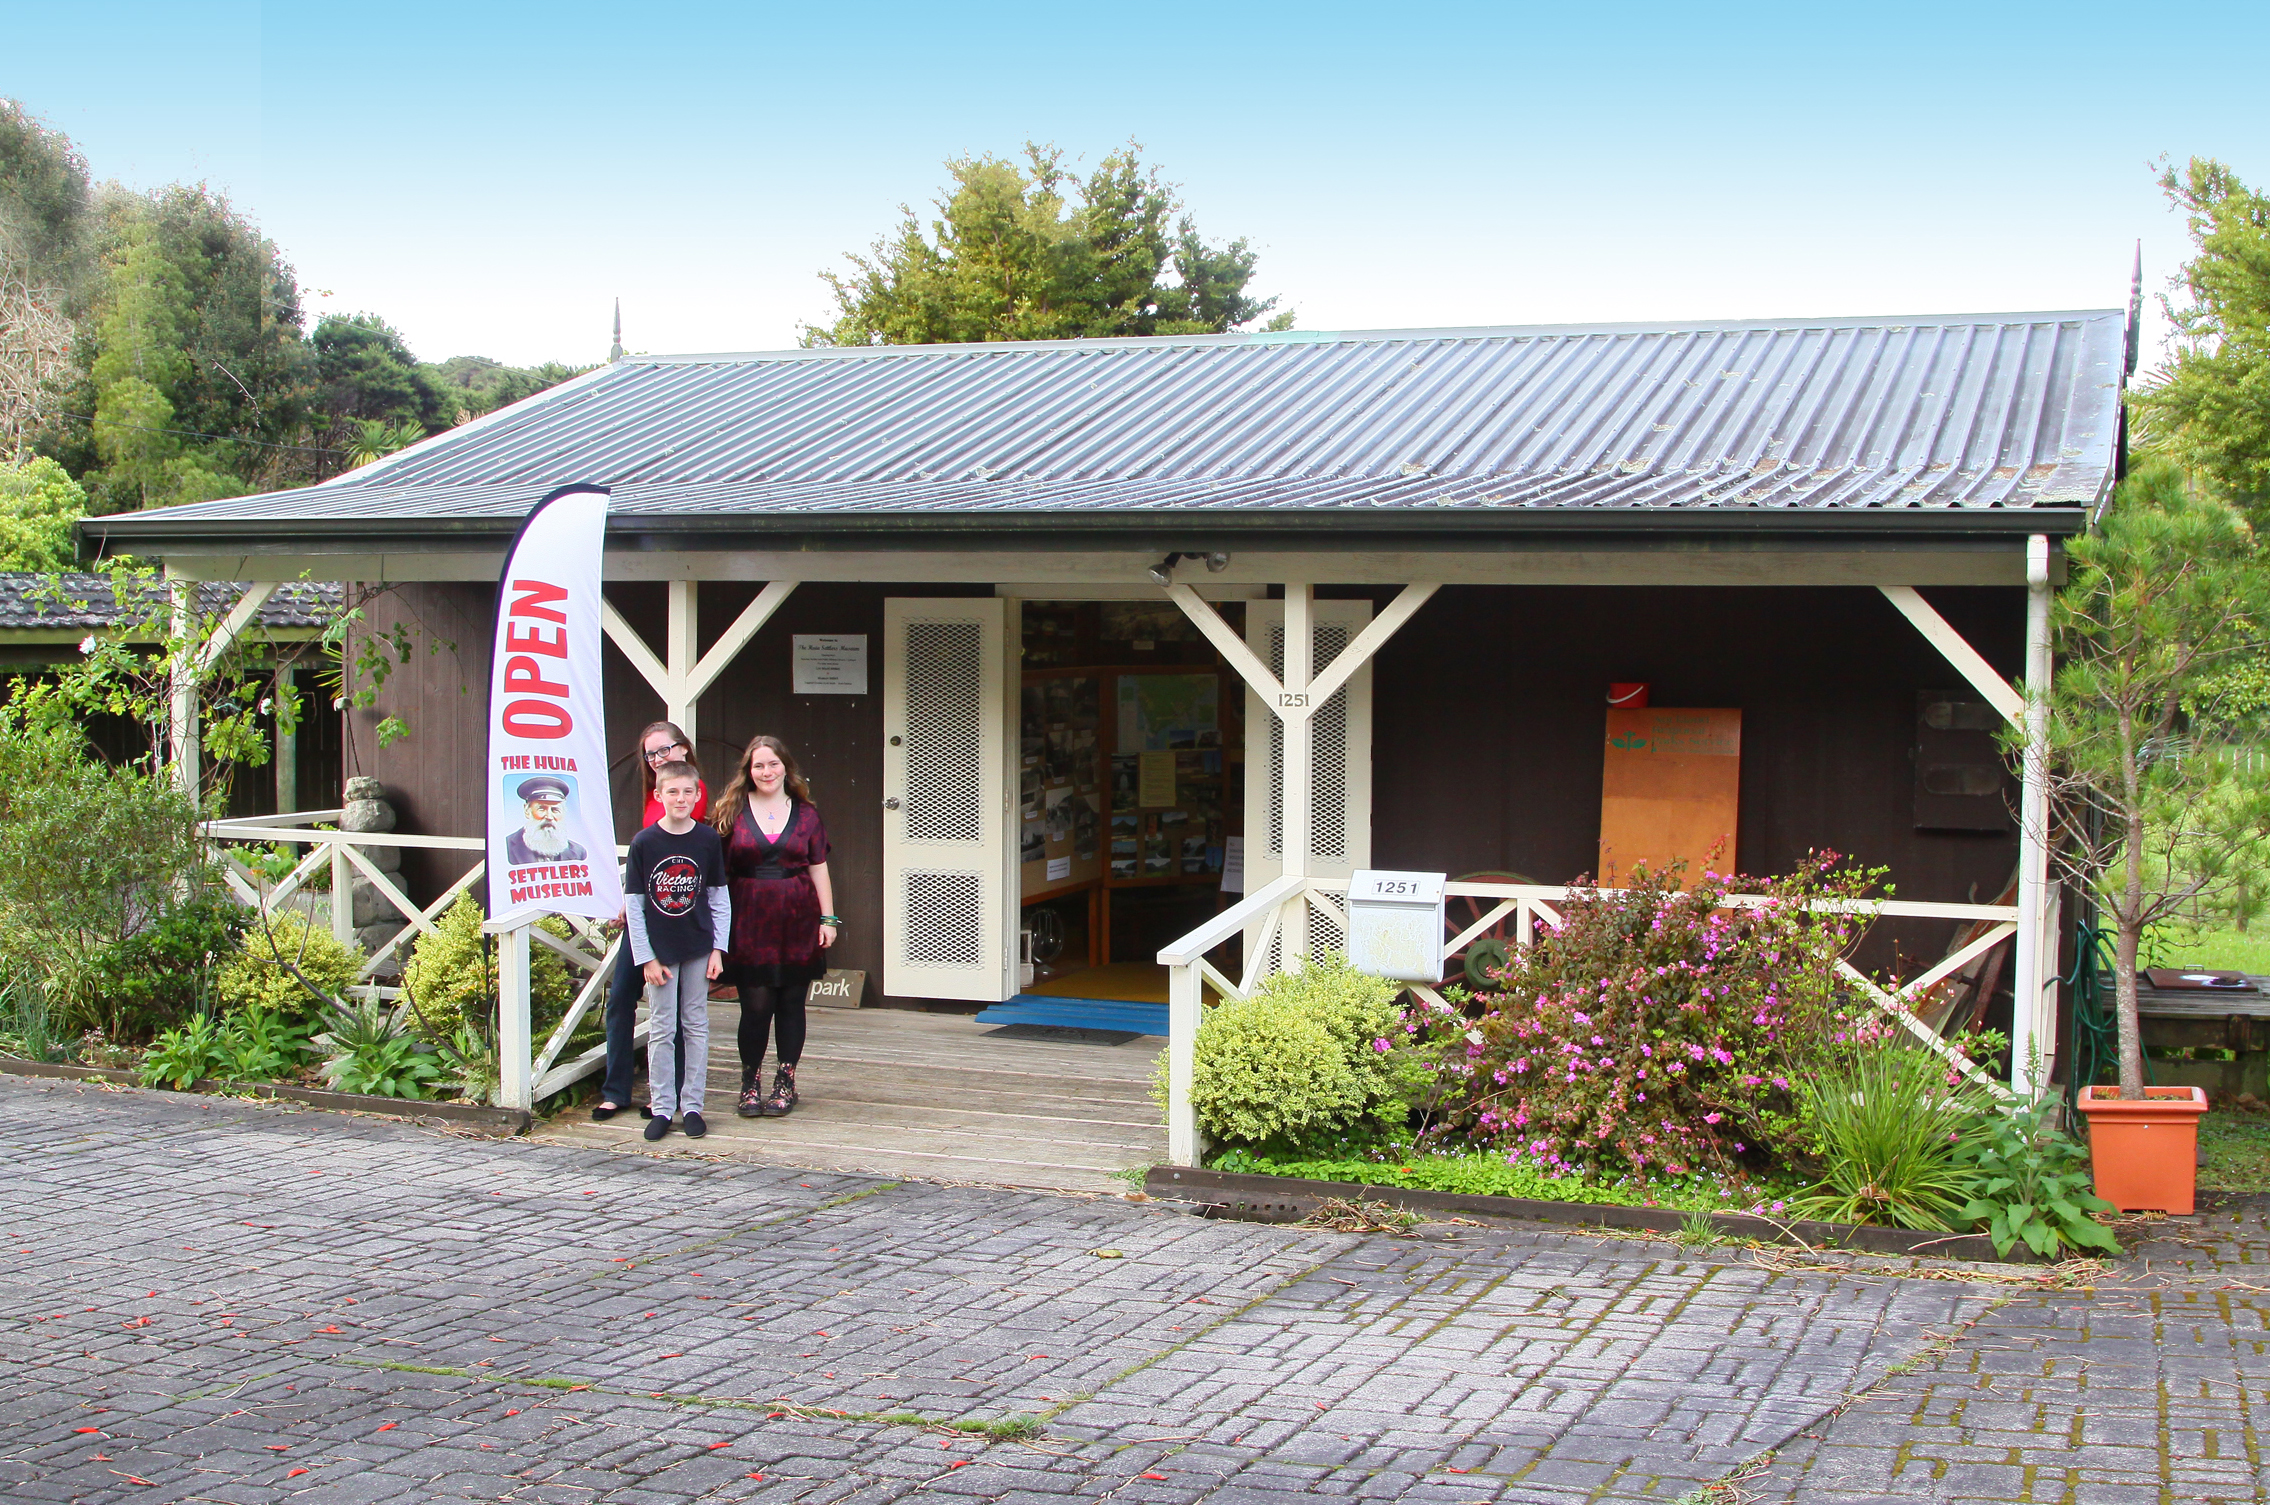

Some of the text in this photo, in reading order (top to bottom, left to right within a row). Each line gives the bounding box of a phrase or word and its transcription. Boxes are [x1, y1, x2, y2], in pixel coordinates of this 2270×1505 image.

[502, 579, 573, 739] OPEN
[1279, 693, 1309, 707] 1251
[501, 755, 578, 772] THE HUIA
[508, 864, 589, 885] SETTLERS
[652, 871, 699, 888] Victory
[510, 881, 593, 905] MUSEUM
[657, 885, 694, 893] RACING
[1376, 881, 1418, 894] 1251
[809, 978, 850, 1001] park
